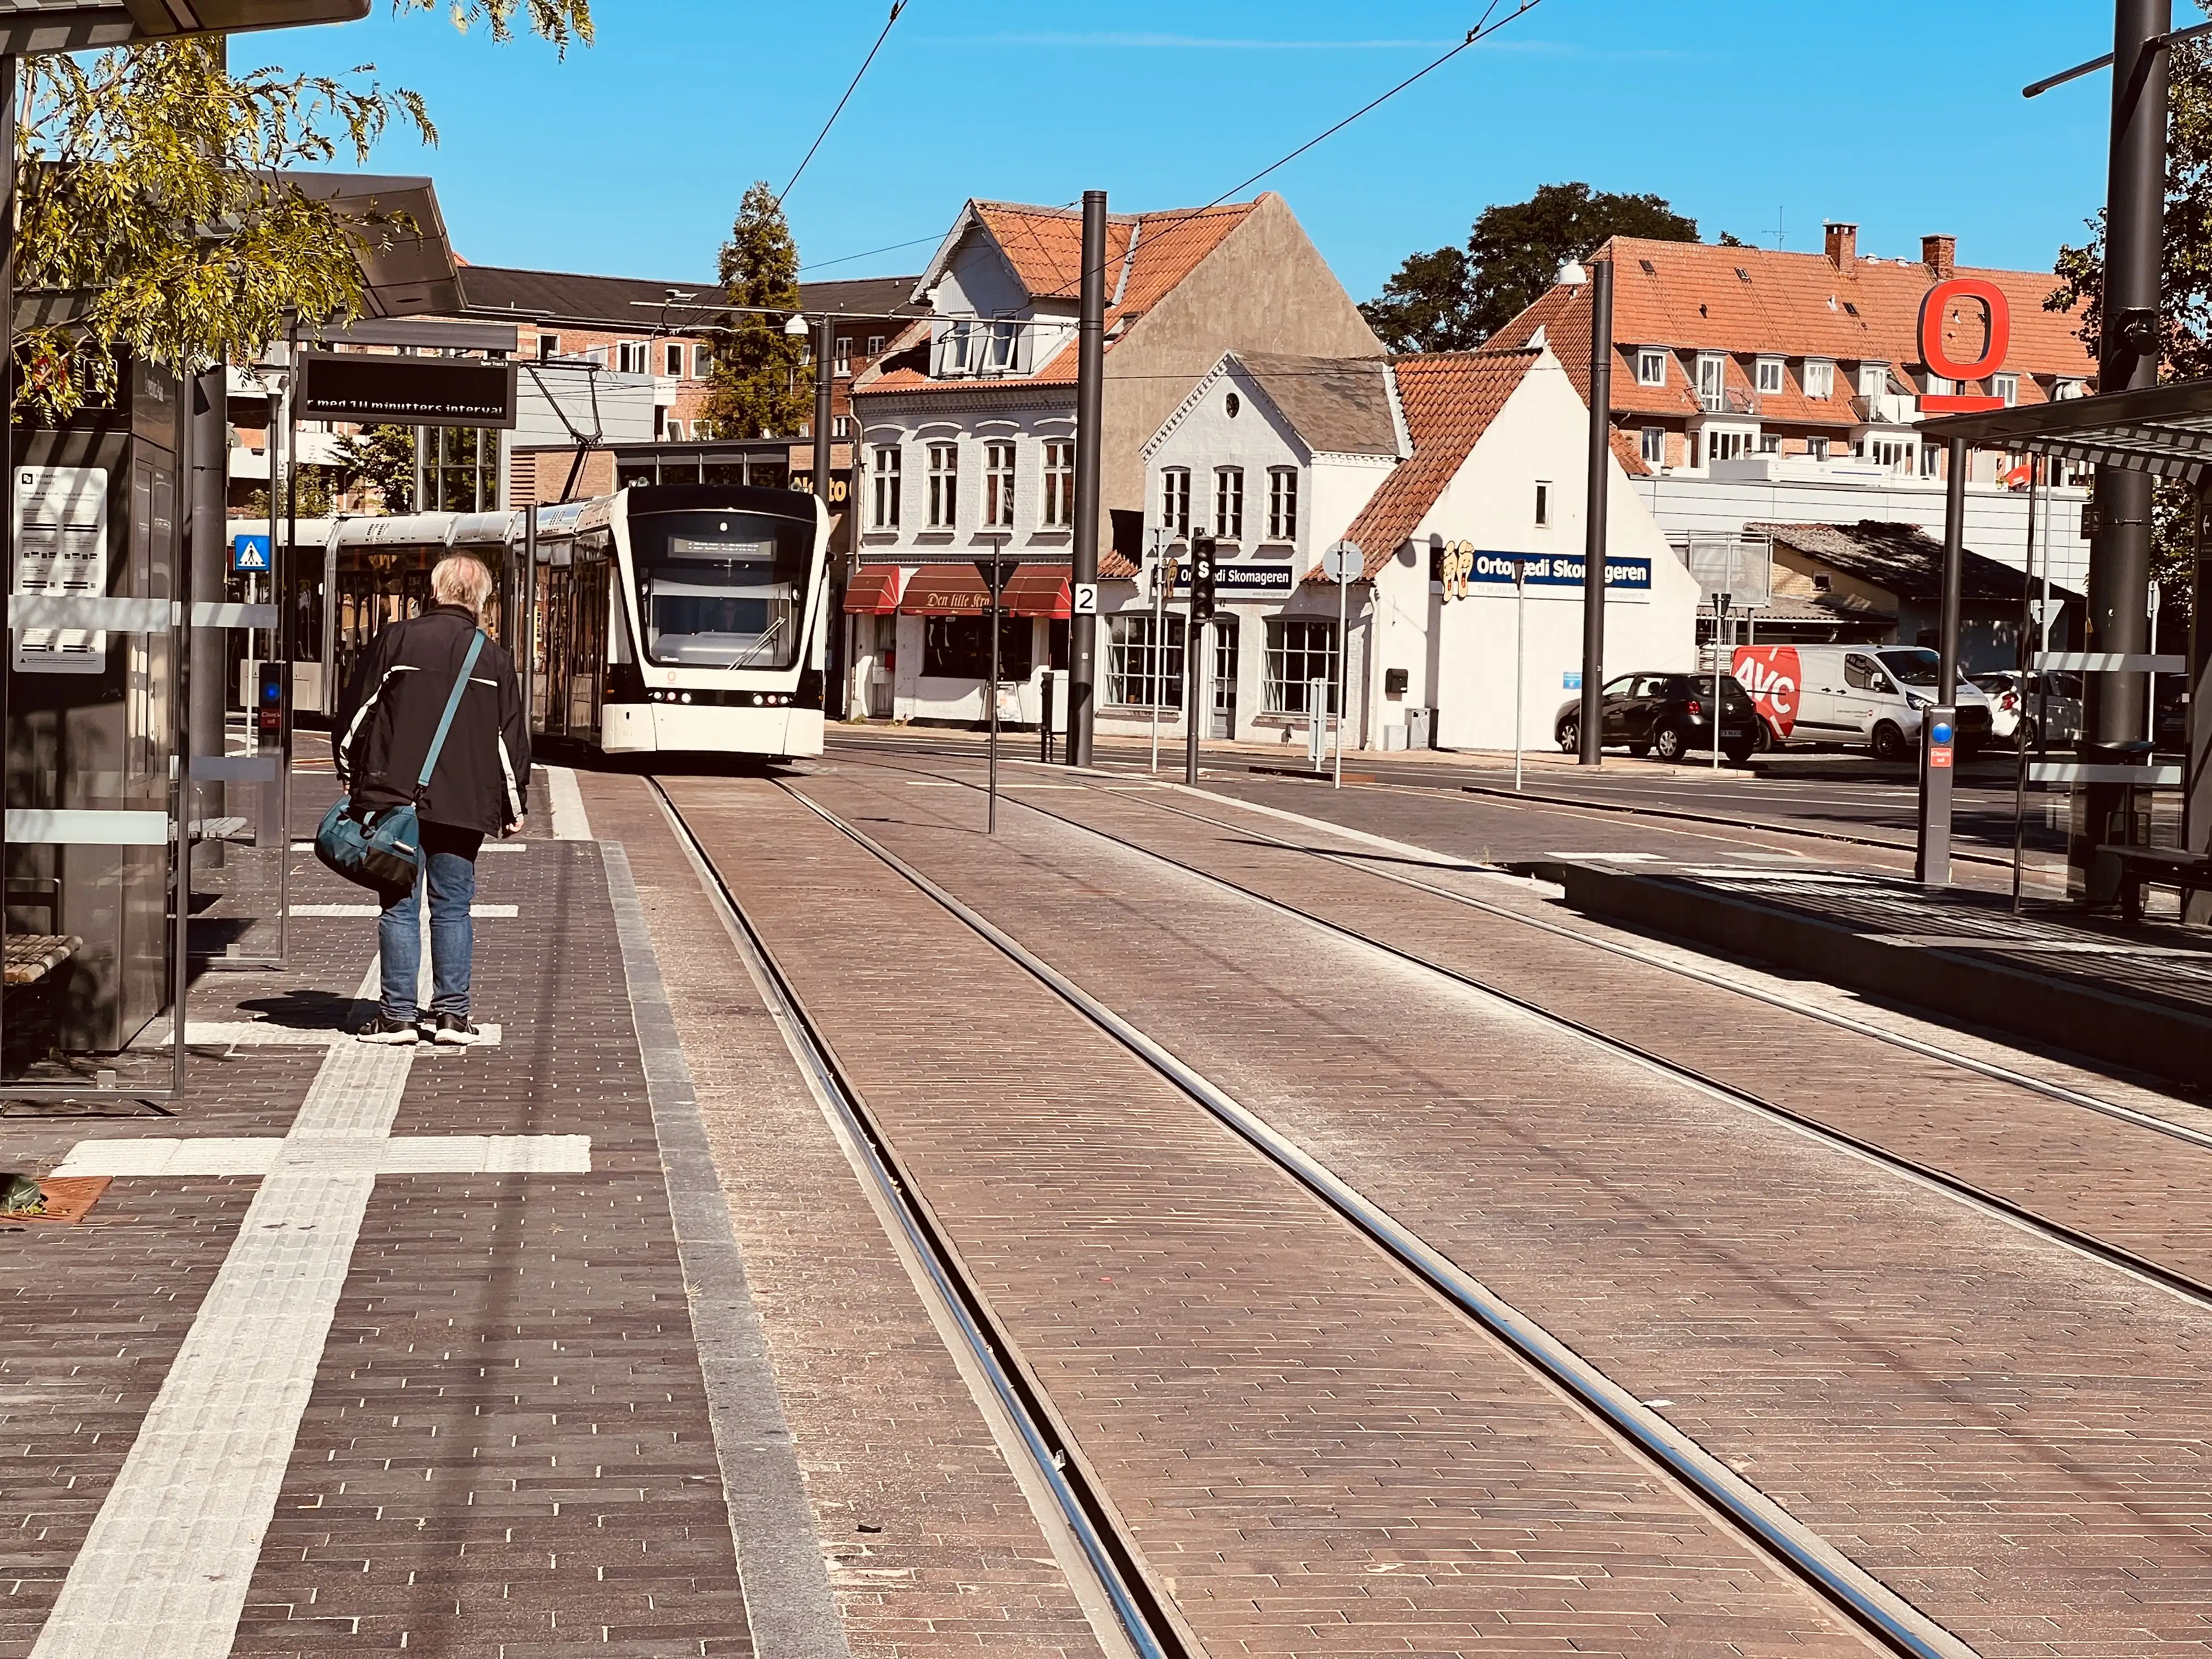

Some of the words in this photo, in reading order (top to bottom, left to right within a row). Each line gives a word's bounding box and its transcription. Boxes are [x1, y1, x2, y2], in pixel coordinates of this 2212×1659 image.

[1228, 569, 1289, 585] Skomageren
[1553, 560, 1647, 583] Skogeren
[926, 593, 948, 607] Den
[951, 594, 969, 607] lille
[1080, 588, 1093, 608] 2
[1734, 656, 1795, 714] AVC
